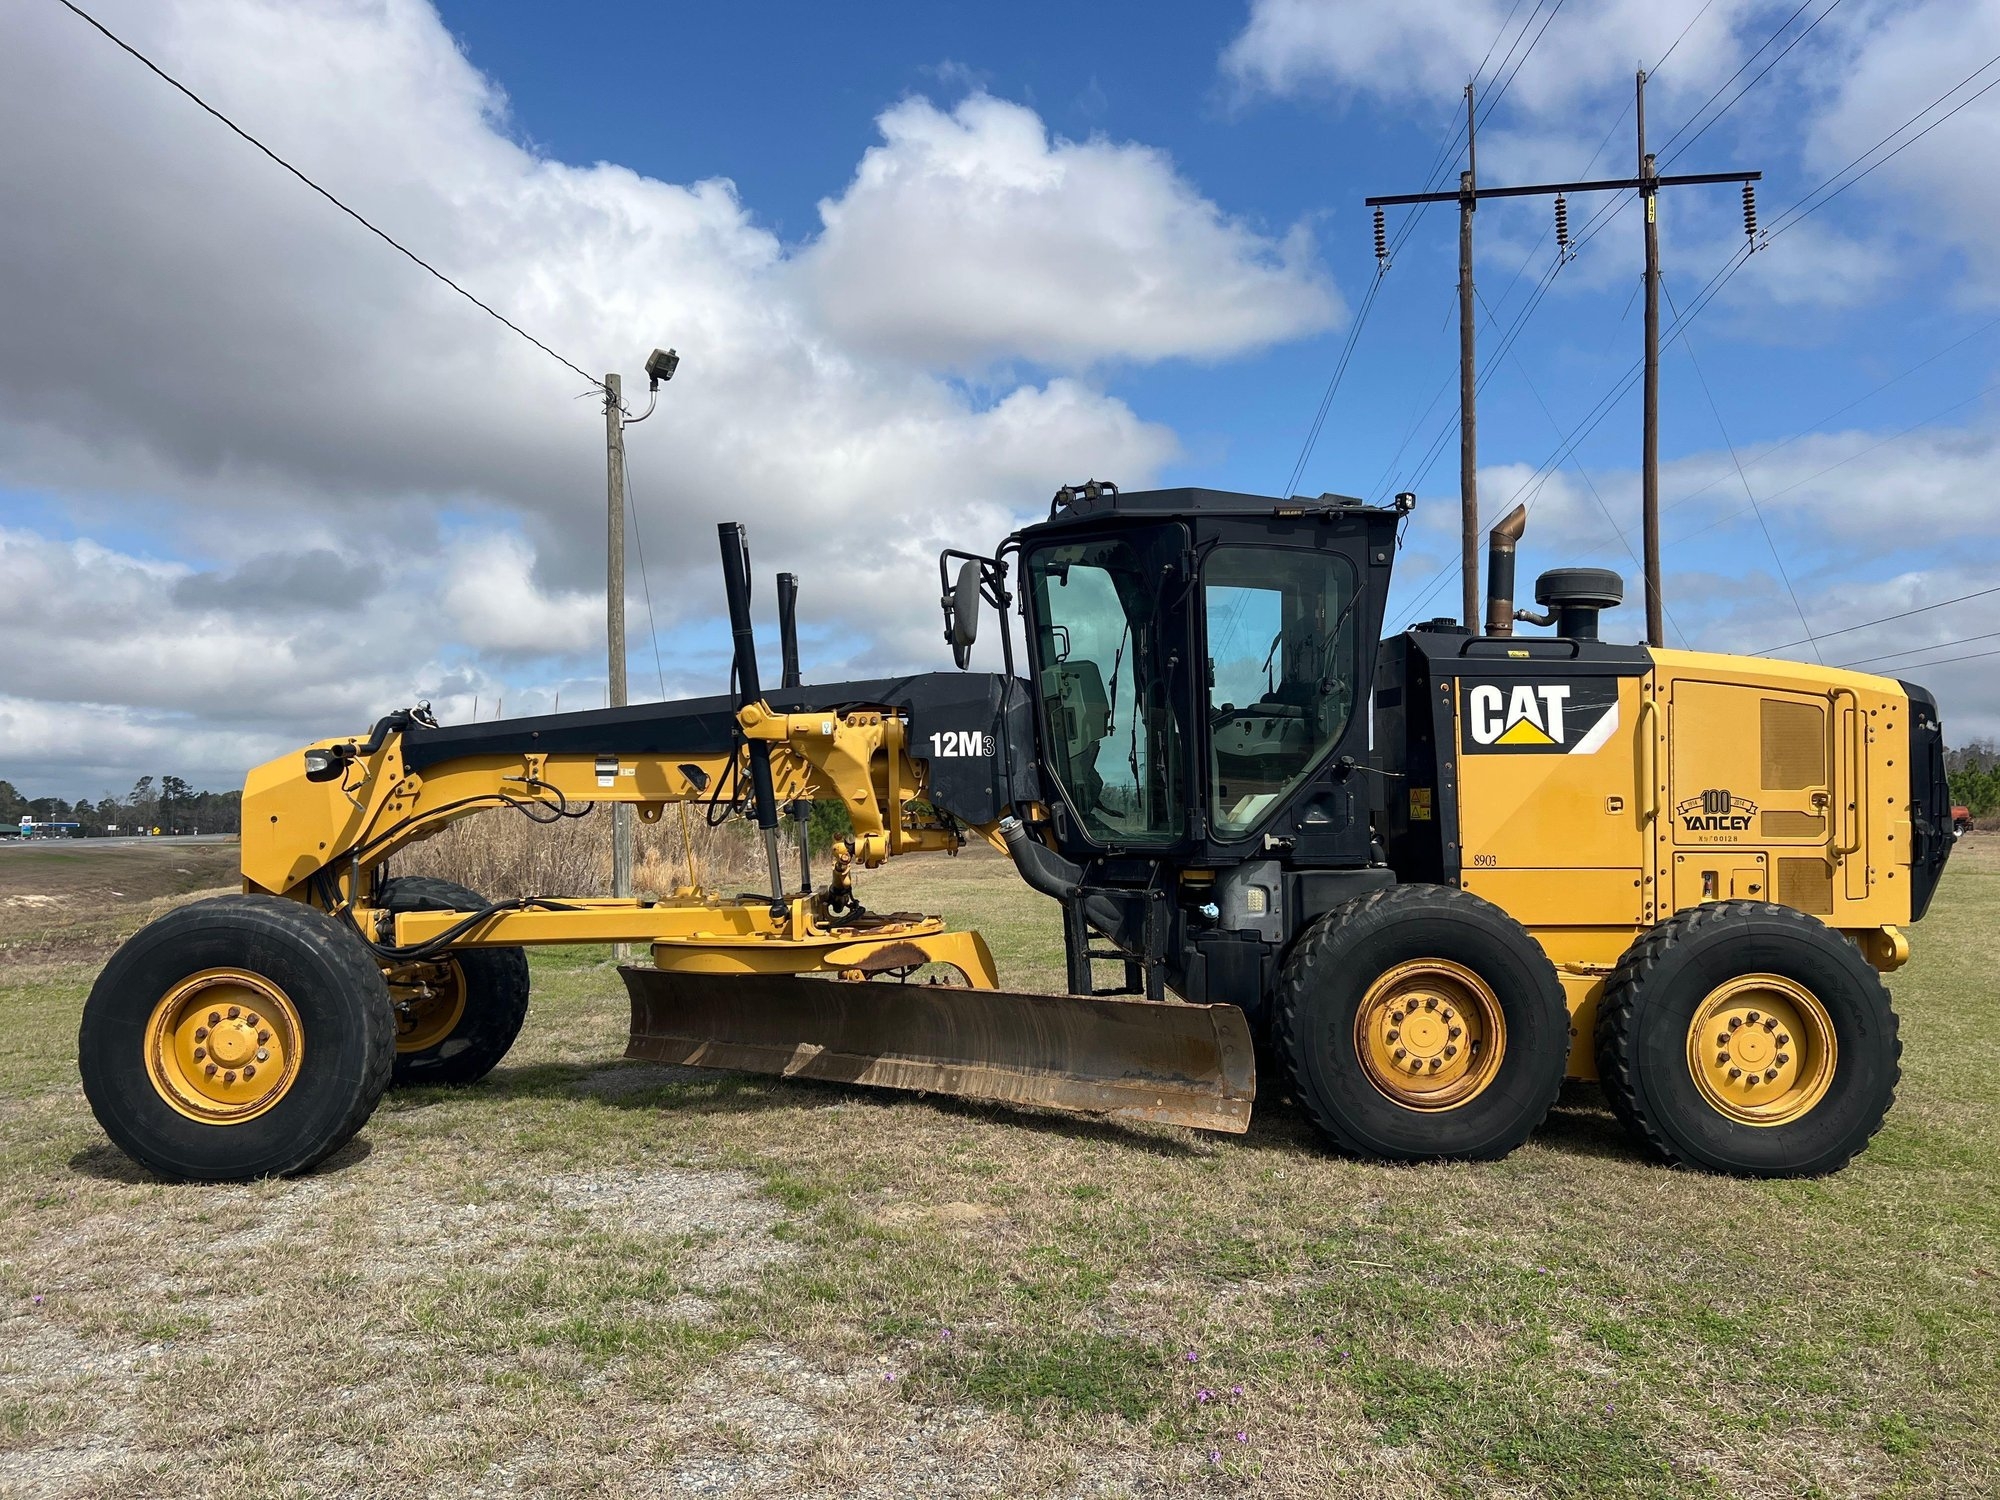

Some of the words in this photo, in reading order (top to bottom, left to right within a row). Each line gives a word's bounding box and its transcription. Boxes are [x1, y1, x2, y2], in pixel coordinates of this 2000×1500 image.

[1470, 685, 1570, 744] CAT
[929, 731, 995, 757] 12M3
[1701, 789, 1731, 815] 100
[1682, 816, 1752, 830] YANCEY
[1474, 854, 1497, 866] 8903
